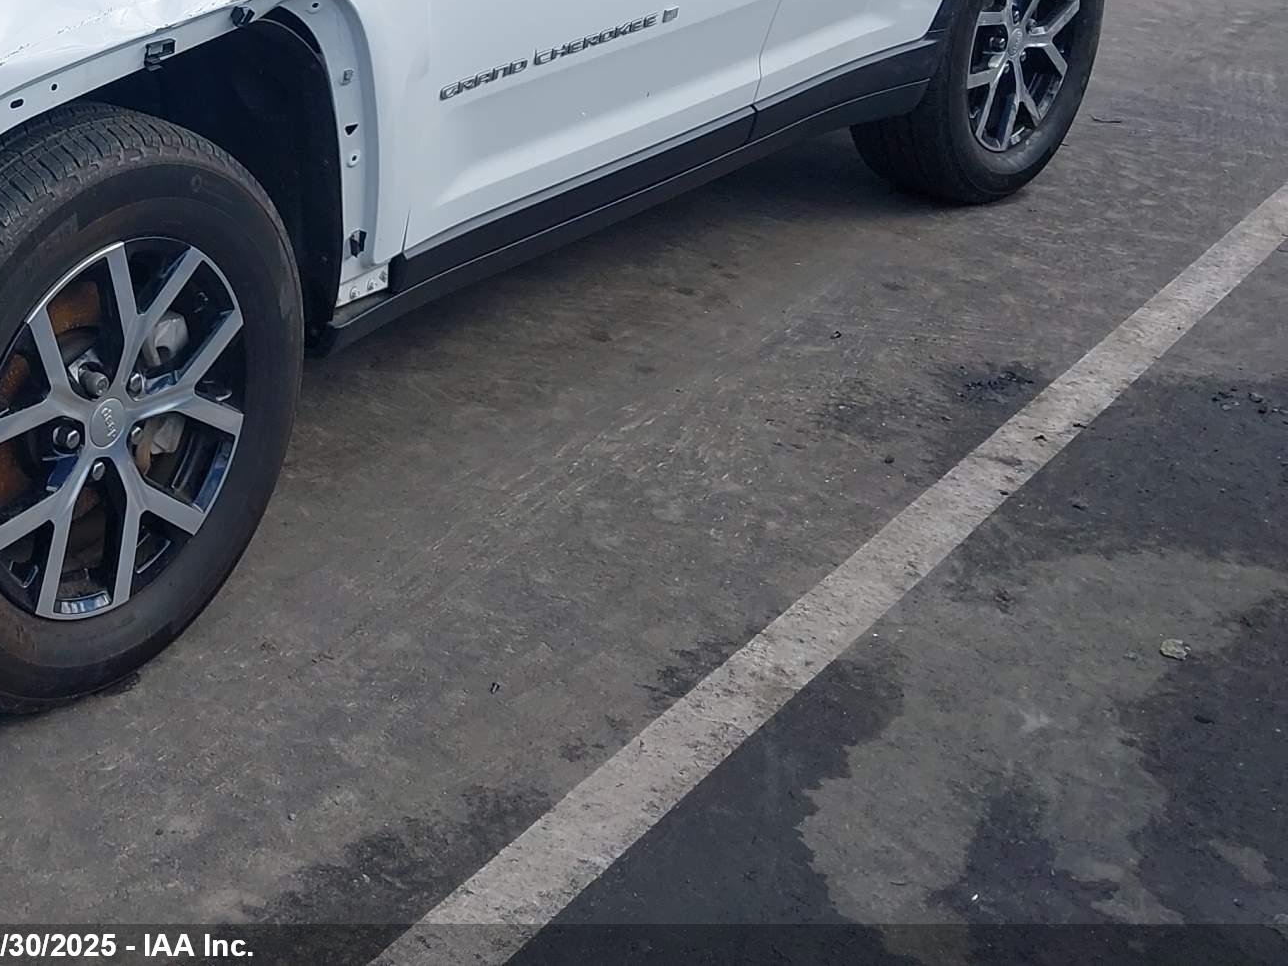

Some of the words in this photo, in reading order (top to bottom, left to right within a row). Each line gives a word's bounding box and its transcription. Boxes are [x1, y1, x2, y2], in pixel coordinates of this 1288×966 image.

[439, 58, 528, 100] GRAND
[533, 11, 659, 66] CHEROKEE
[101, 407, 116, 438] Jeep
